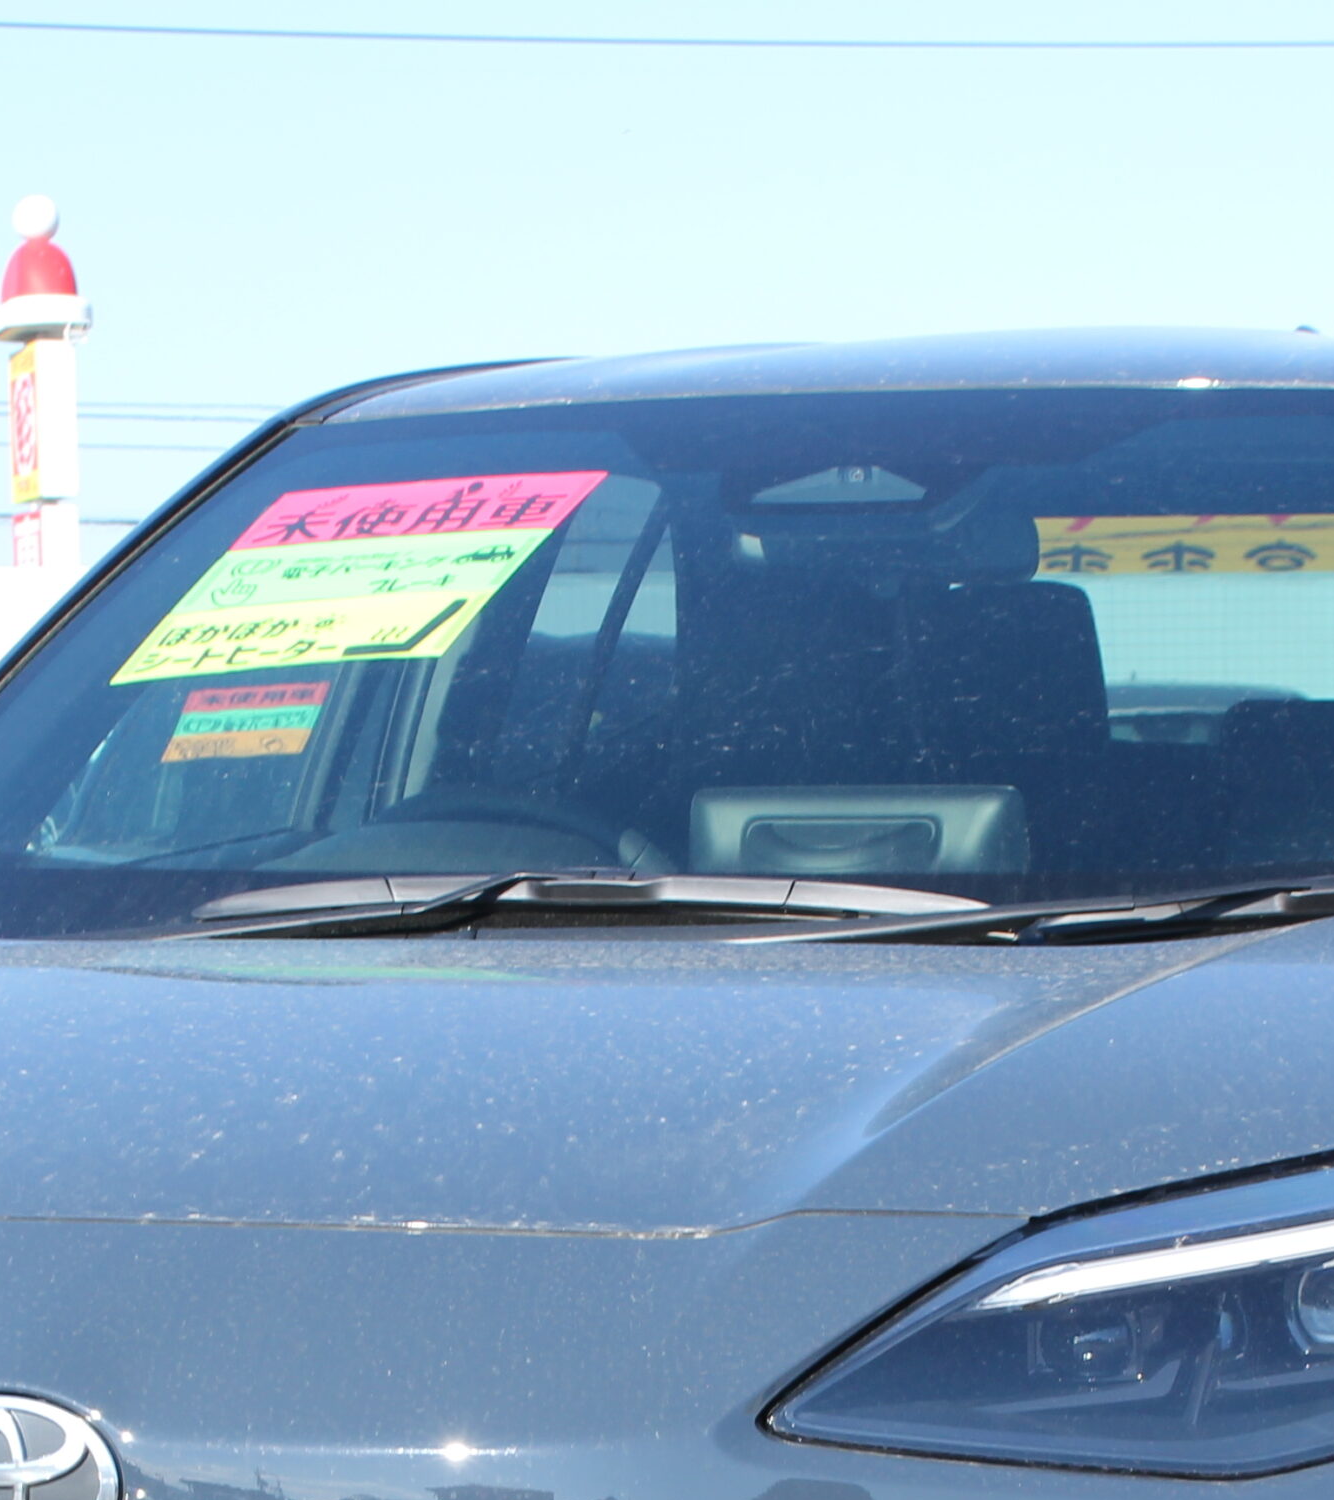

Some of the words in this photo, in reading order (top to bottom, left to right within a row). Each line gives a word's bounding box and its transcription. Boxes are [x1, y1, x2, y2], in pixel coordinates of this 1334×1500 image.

[252, 487, 568, 543] 未使用車
[134, 640, 337, 673] シートヒーター
